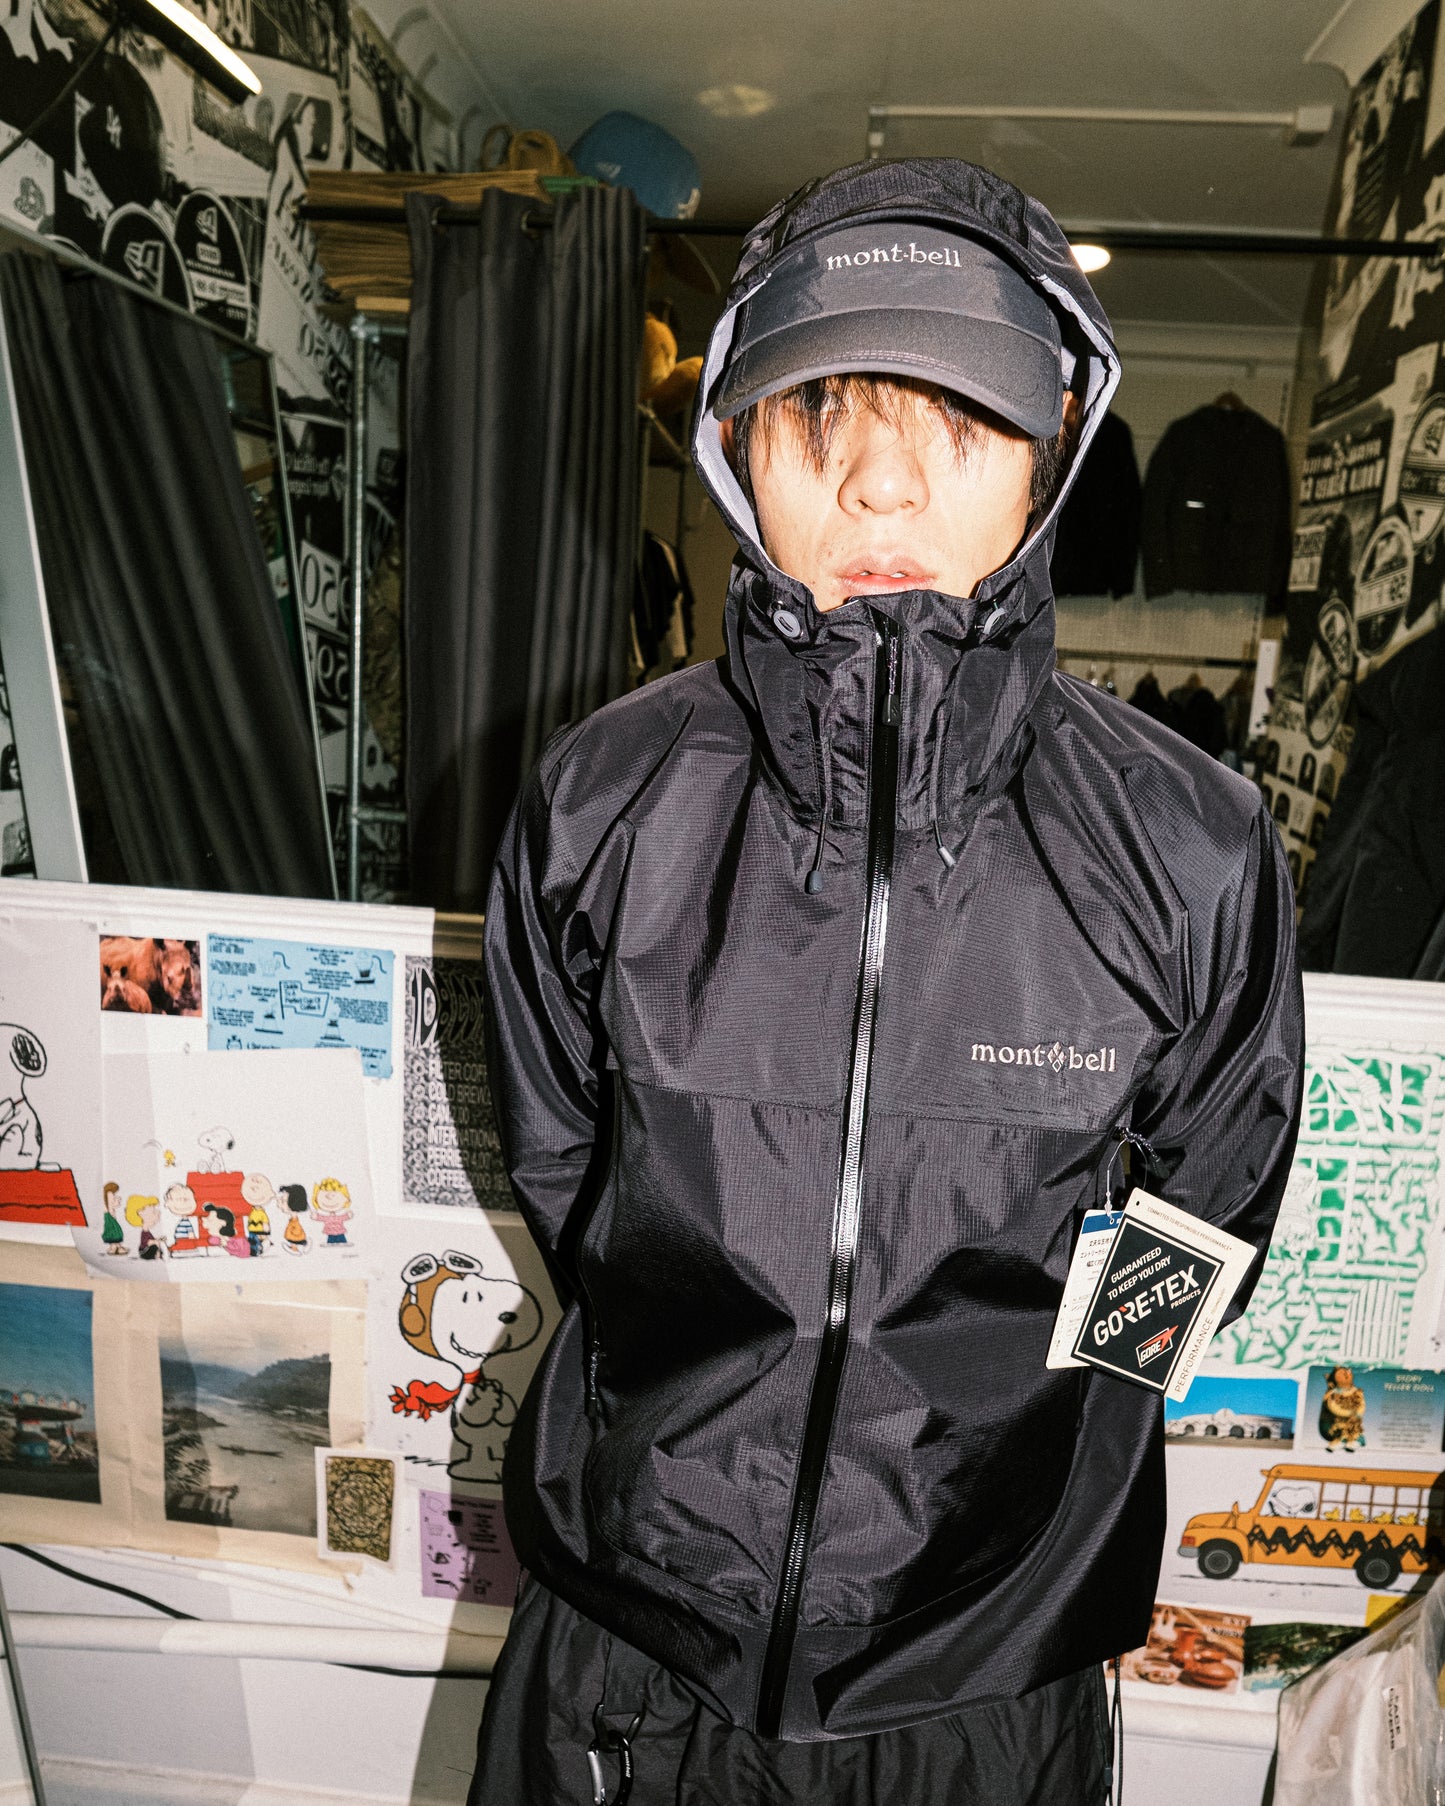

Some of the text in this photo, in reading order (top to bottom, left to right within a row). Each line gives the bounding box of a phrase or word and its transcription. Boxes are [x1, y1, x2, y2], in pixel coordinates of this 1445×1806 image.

[1107, 1290, 1119, 1301] TO
[1116, 1276, 1138, 1295] KEEP
[1138, 1265, 1155, 1281] YOU
[1154, 1255, 1171, 1272] DRY
[1111, 1247, 1162, 1283] GUARANTEED
[1093, 1264, 1200, 1346] GORE-TEX
[1170, 1288, 1202, 1309] PRODUCTS
[1140, 1340, 1162, 1362] GORE
[1174, 1318, 1214, 1393] PERFORMANCE
